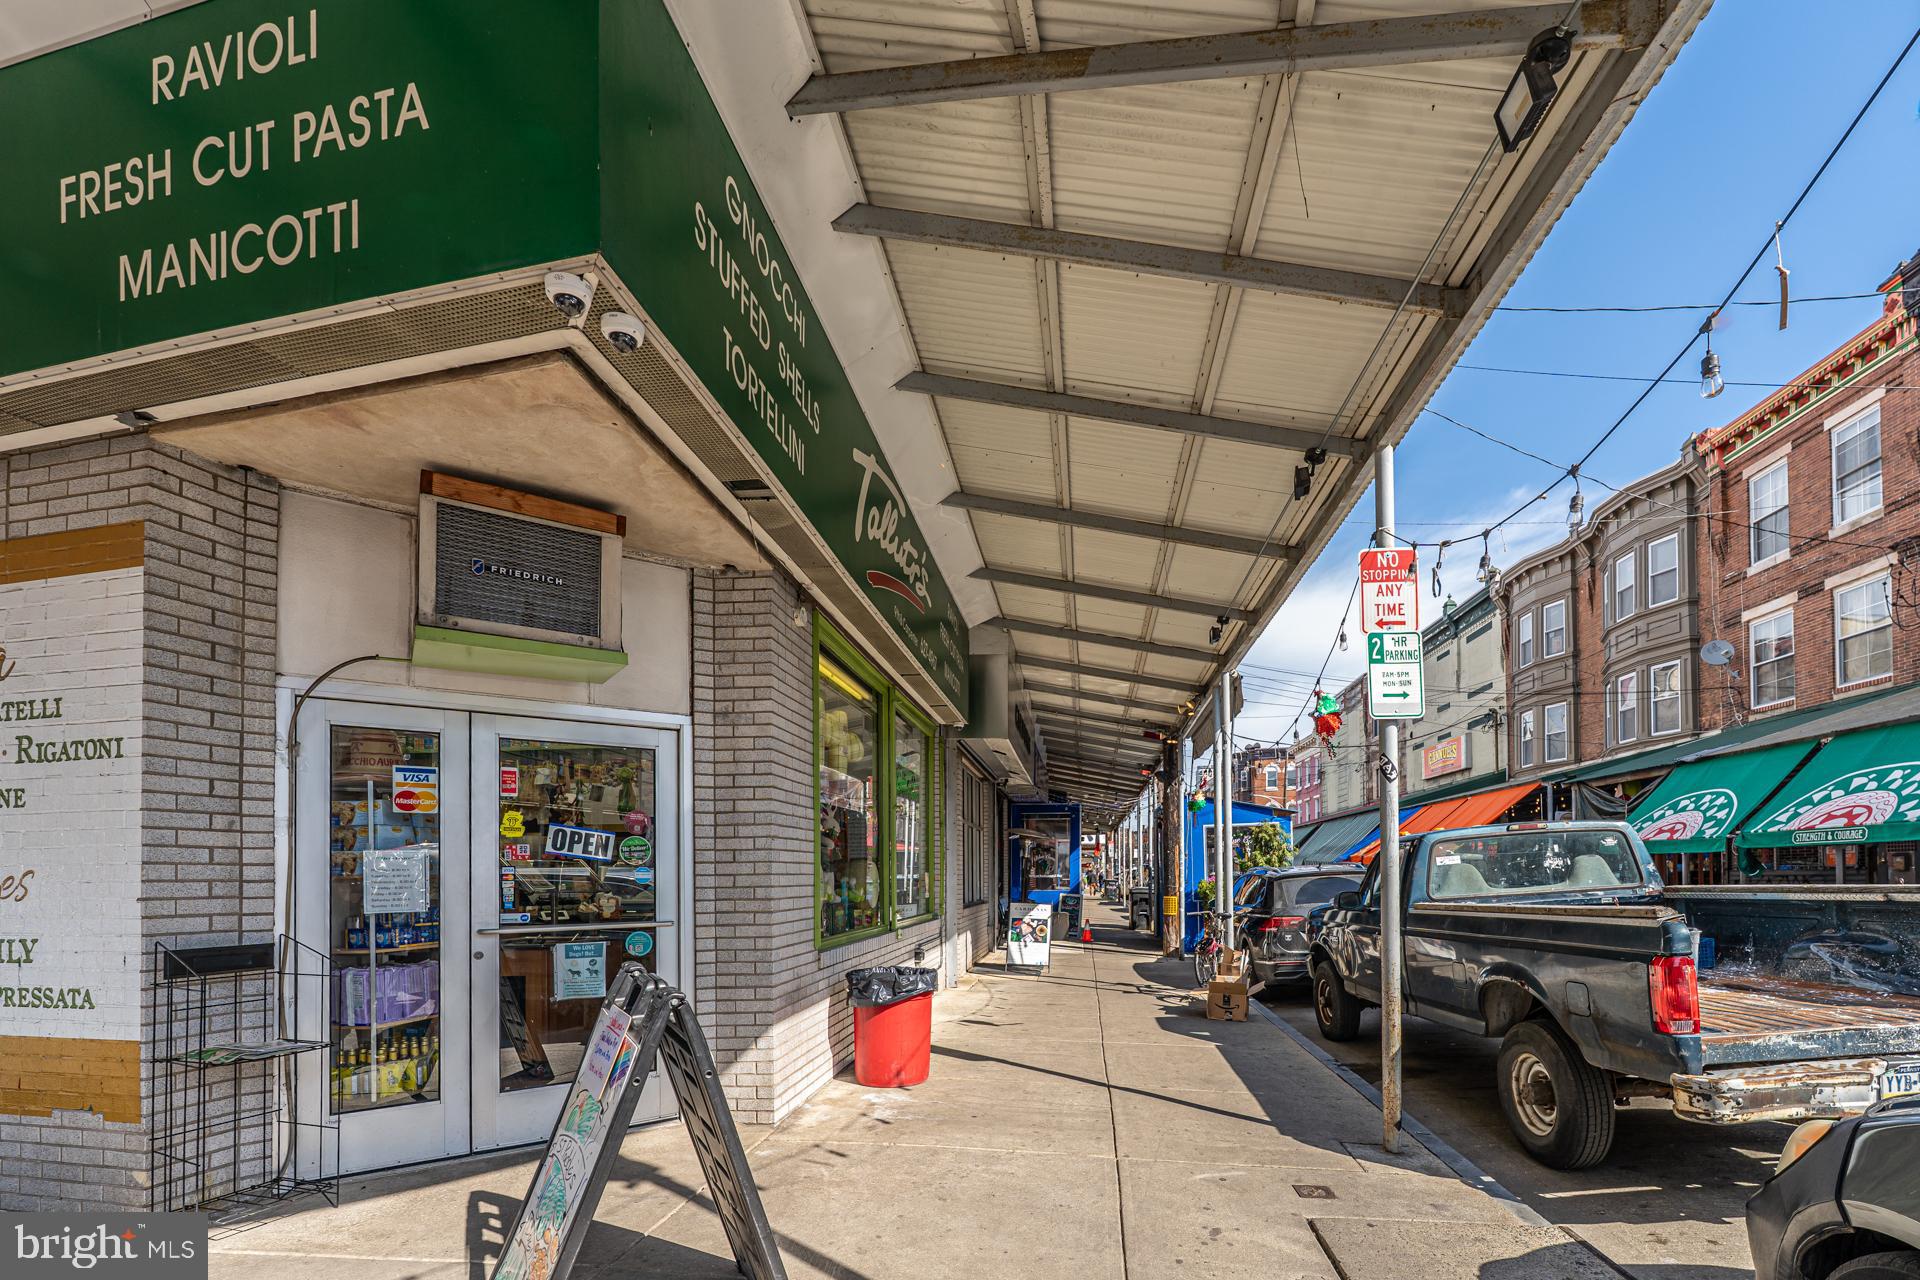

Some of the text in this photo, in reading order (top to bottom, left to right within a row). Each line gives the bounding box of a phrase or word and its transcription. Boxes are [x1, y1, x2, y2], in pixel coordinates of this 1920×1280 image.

[152, 9, 318, 104] RAVIOLI
[60, 82, 430, 224] FRESH CUT PASTA
[119, 199, 359, 301] MANICOTTI
[725, 175, 806, 348] GNOCCHI
[694, 201, 820, 435] STUFFED SHELLS
[723, 325, 805, 477] TORTELLINI
[1377, 551, 1399, 568] NO
[491, 565, 563, 586] FRIEDRICH
[1376, 584, 1403, 597] ANY
[1375, 603, 1406, 616] TIME
[1371, 637, 1408, 660] 2 HR
[1385, 650, 1419, 661] PARKING
[0, 697, 63, 722] TELLI
[403, 773, 430, 783] VISA
[395, 797, 437, 805] MasterCard
[551, 828, 611, 858] OPEN
[1795, 832, 1826, 842] STRENGTH
[1834, 829, 1863, 840] COURAGE
[0, 986, 96, 1010] RESSATA
[1886, 1073, 1920, 1092] YYB-
